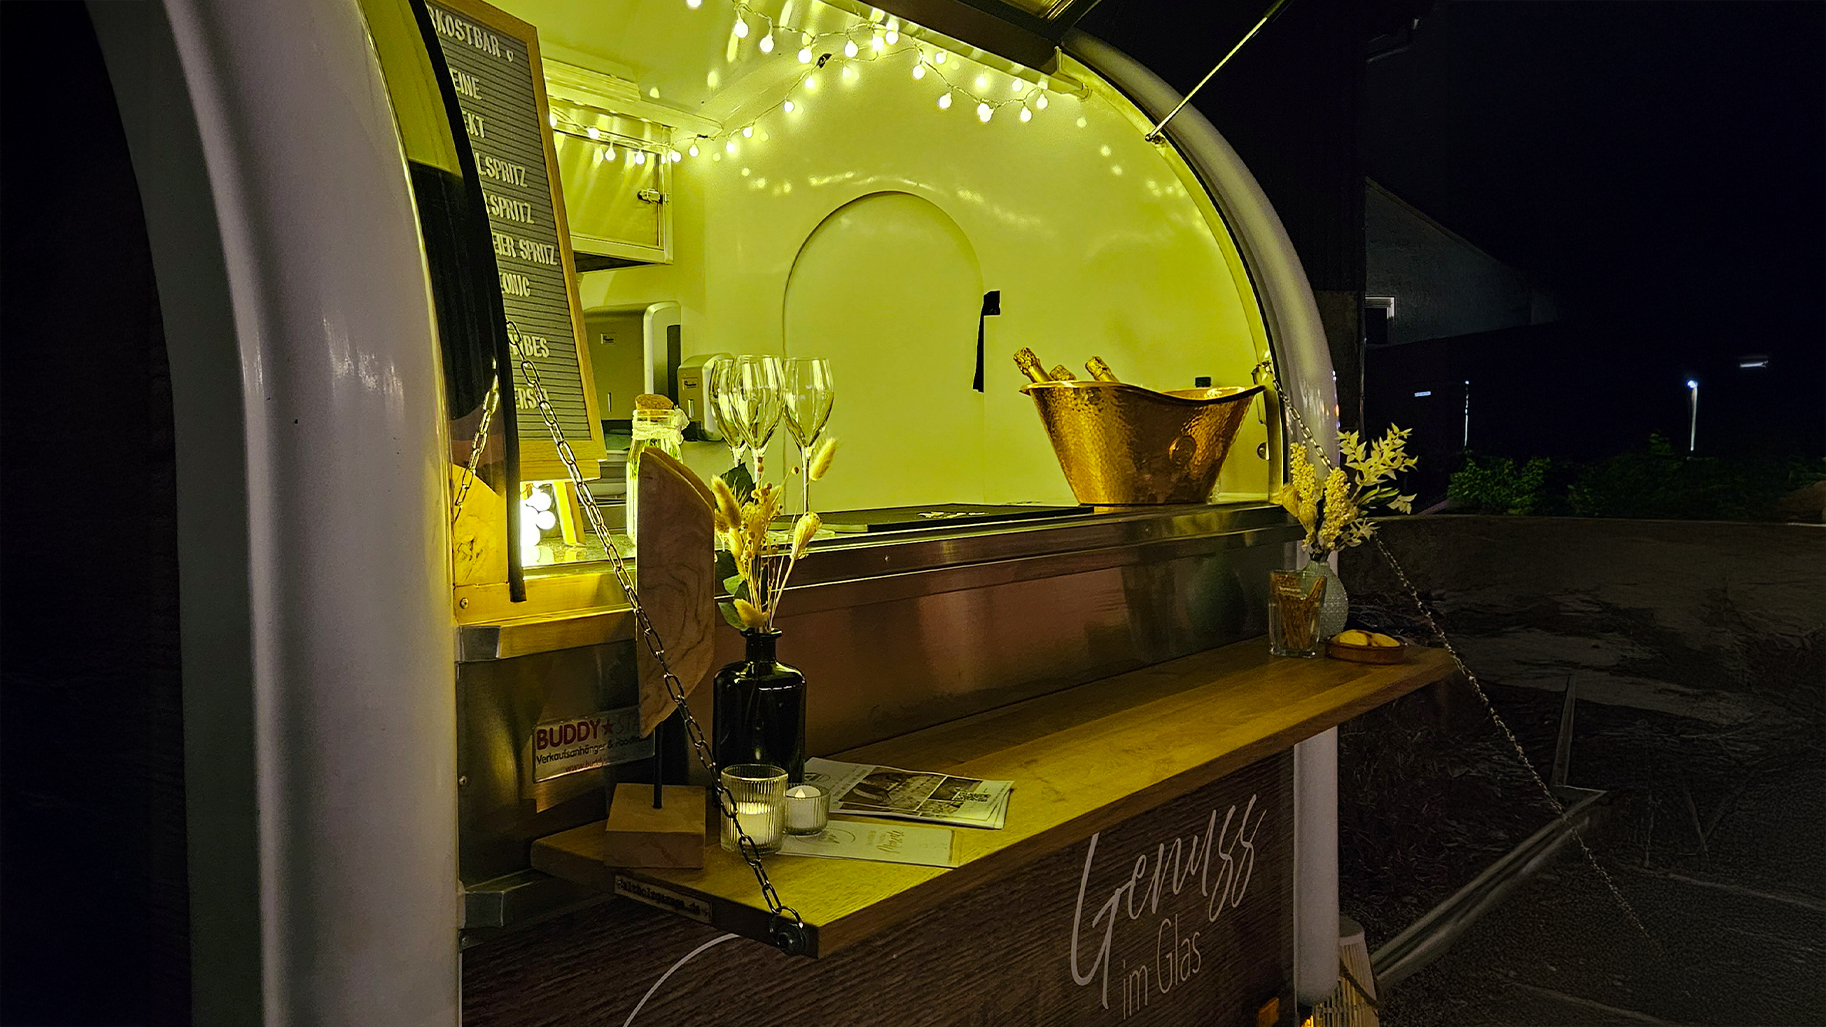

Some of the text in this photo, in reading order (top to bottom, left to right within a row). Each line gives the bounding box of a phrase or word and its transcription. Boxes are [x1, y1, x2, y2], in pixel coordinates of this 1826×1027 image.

[519, 238, 559, 266] SPRITZ
[499, 271, 531, 298] ONIC
[537, 718, 601, 751] BUDDY
[1070, 793, 1267, 1010] Genuss
[1122, 913, 1203, 1020] im Glas
